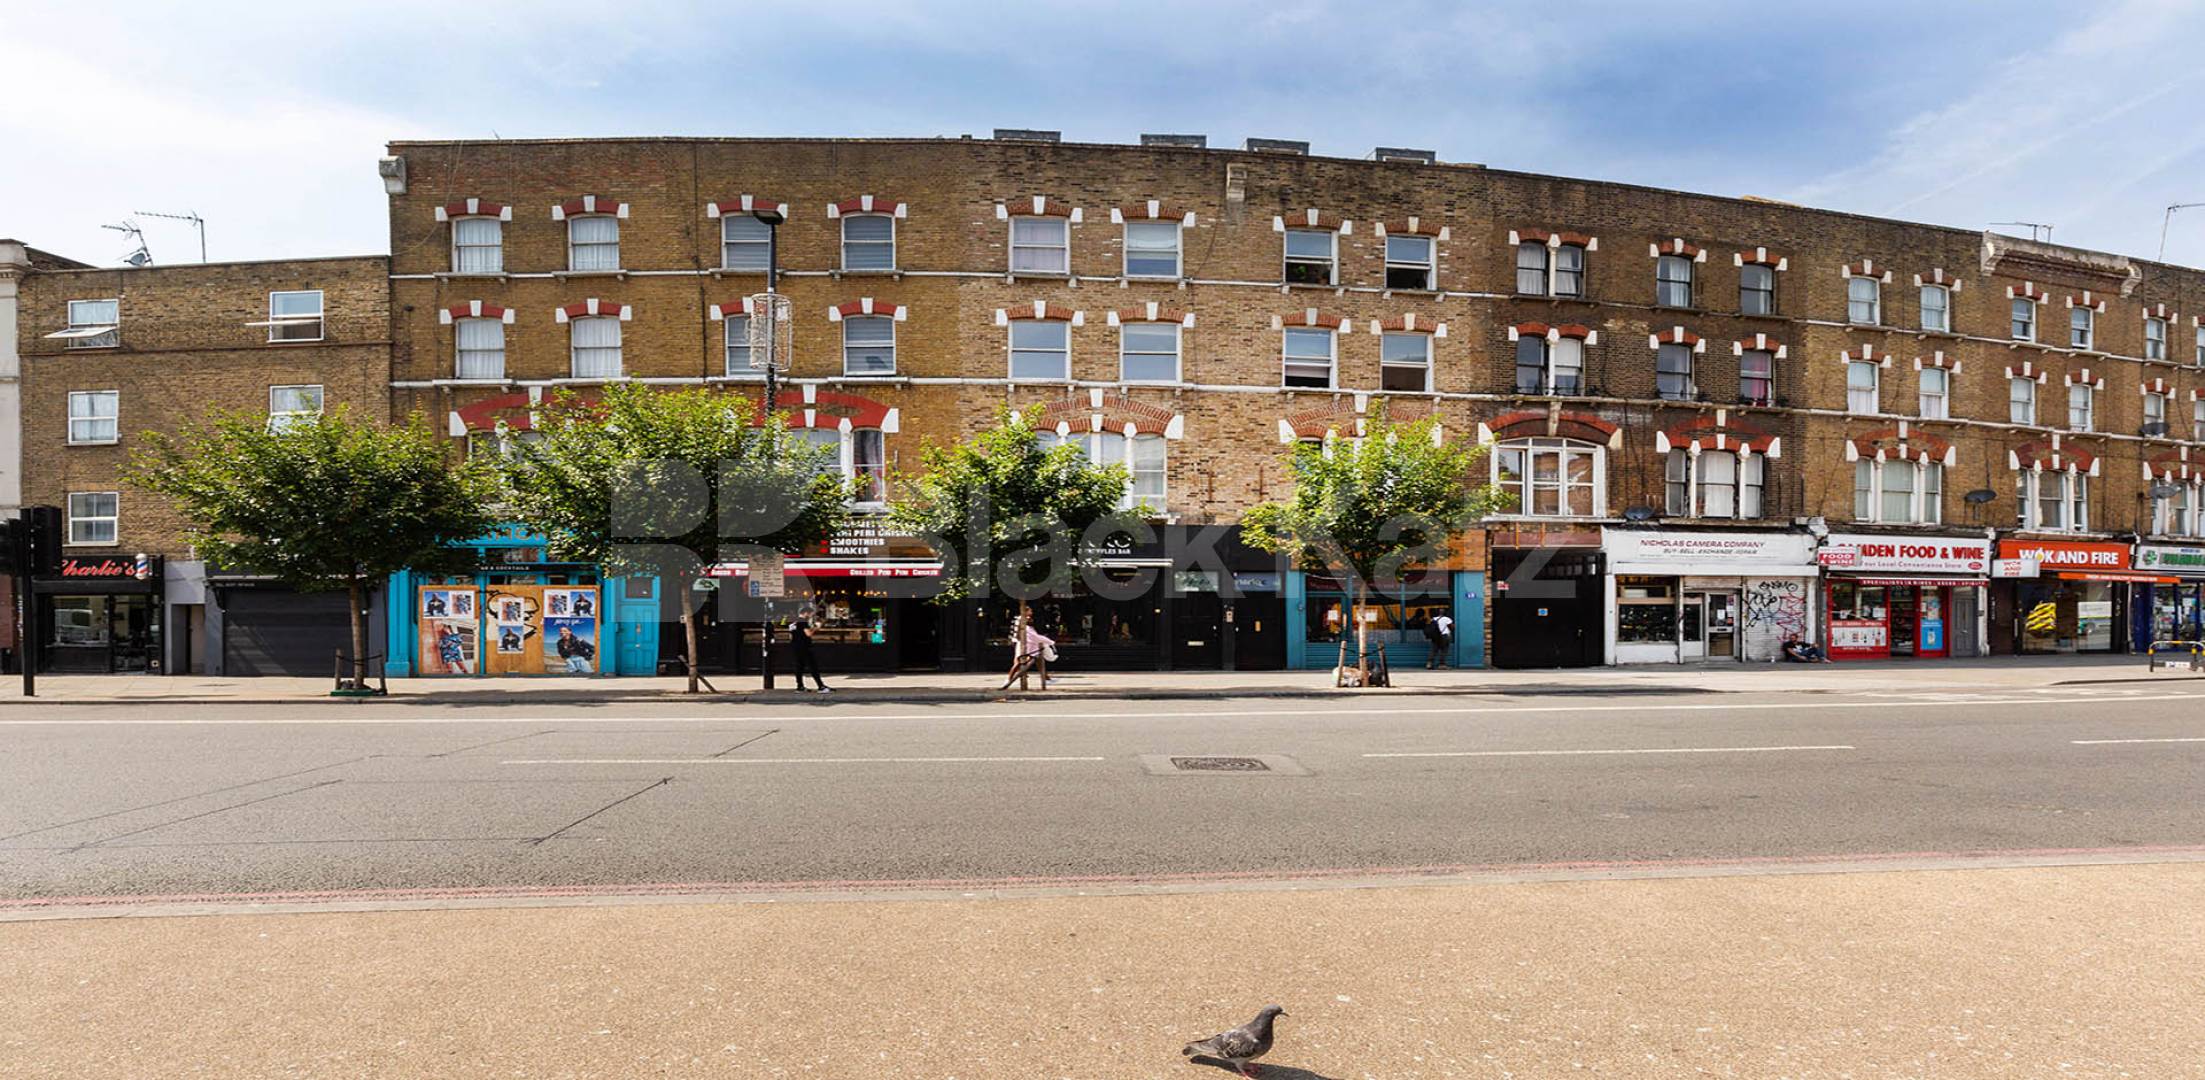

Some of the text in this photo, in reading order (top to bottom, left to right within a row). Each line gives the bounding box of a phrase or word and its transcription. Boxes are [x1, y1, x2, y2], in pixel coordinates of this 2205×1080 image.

[854, 529, 876, 537] PERI
[830, 538, 885, 546] SMOOTHIES
[1640, 539, 1765, 549] NICHOLAS CAMERA COMPANY
[830, 547, 870, 555] SHAKES
[1838, 543, 1985, 560] MDEN FOOD & WINE
[2018, 547, 2120, 565] WOK AND FIRE
